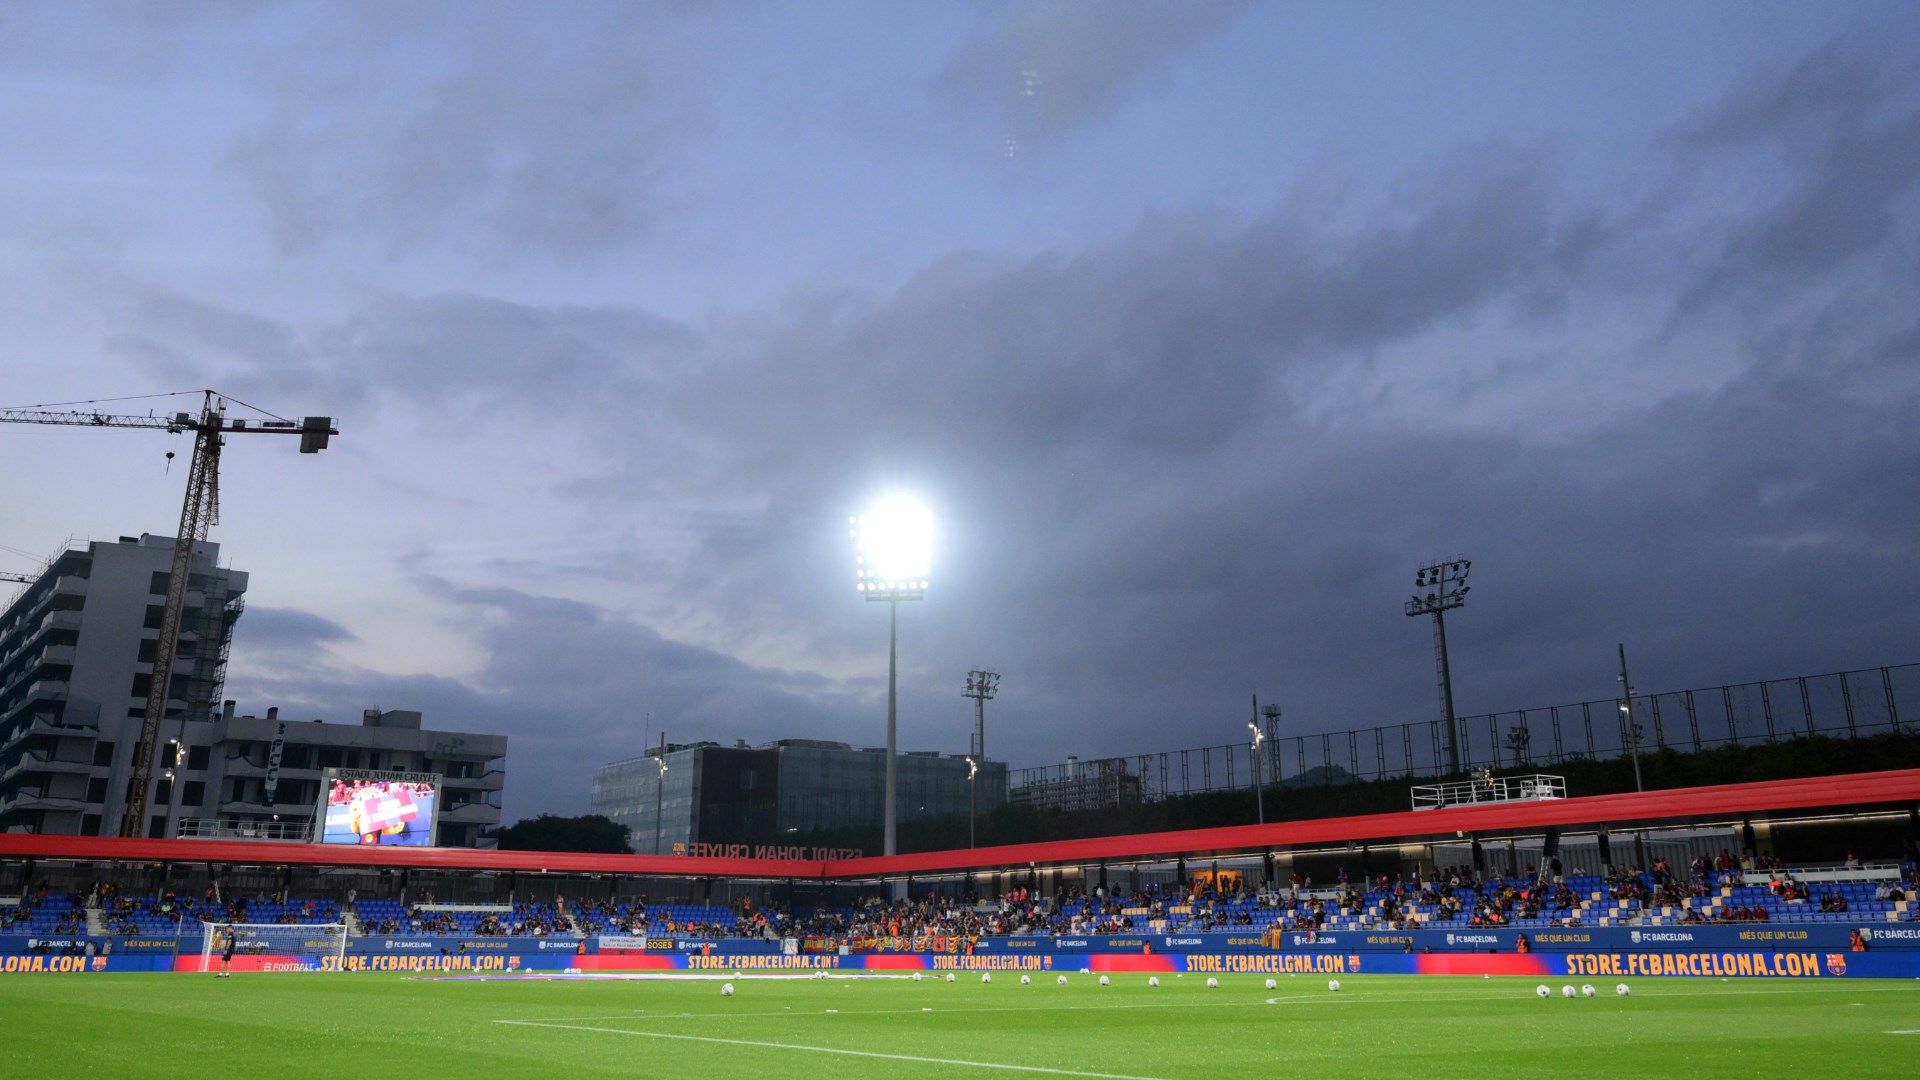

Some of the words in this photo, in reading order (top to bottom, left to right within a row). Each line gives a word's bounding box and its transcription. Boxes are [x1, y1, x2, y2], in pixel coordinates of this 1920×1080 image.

[340, 769, 370, 779] ESTADI
[372, 770, 402, 781] JOHAN
[1535, 933, 1549, 942] MÉS
[1549, 935, 1562, 943] QUE
[1642, 933, 1651, 941] FC
[1652, 933, 1693, 942] BARCELONA
[1739, 930, 1757, 940] MÉS
[1757, 932, 1773, 941] QUE
[1787, 931, 1808, 939] CLUB
[1873, 930, 1885, 939] FC
[648, 941, 673, 949] SOSES
[1367, 936, 1379, 944] MÉS
[1379, 937, 1389, 945] QUE
[1186, 954, 1344, 972] STORE.FCBARCELONA.COM
[1566, 953, 1820, 976] STORE.FCBARCELONA.COM
